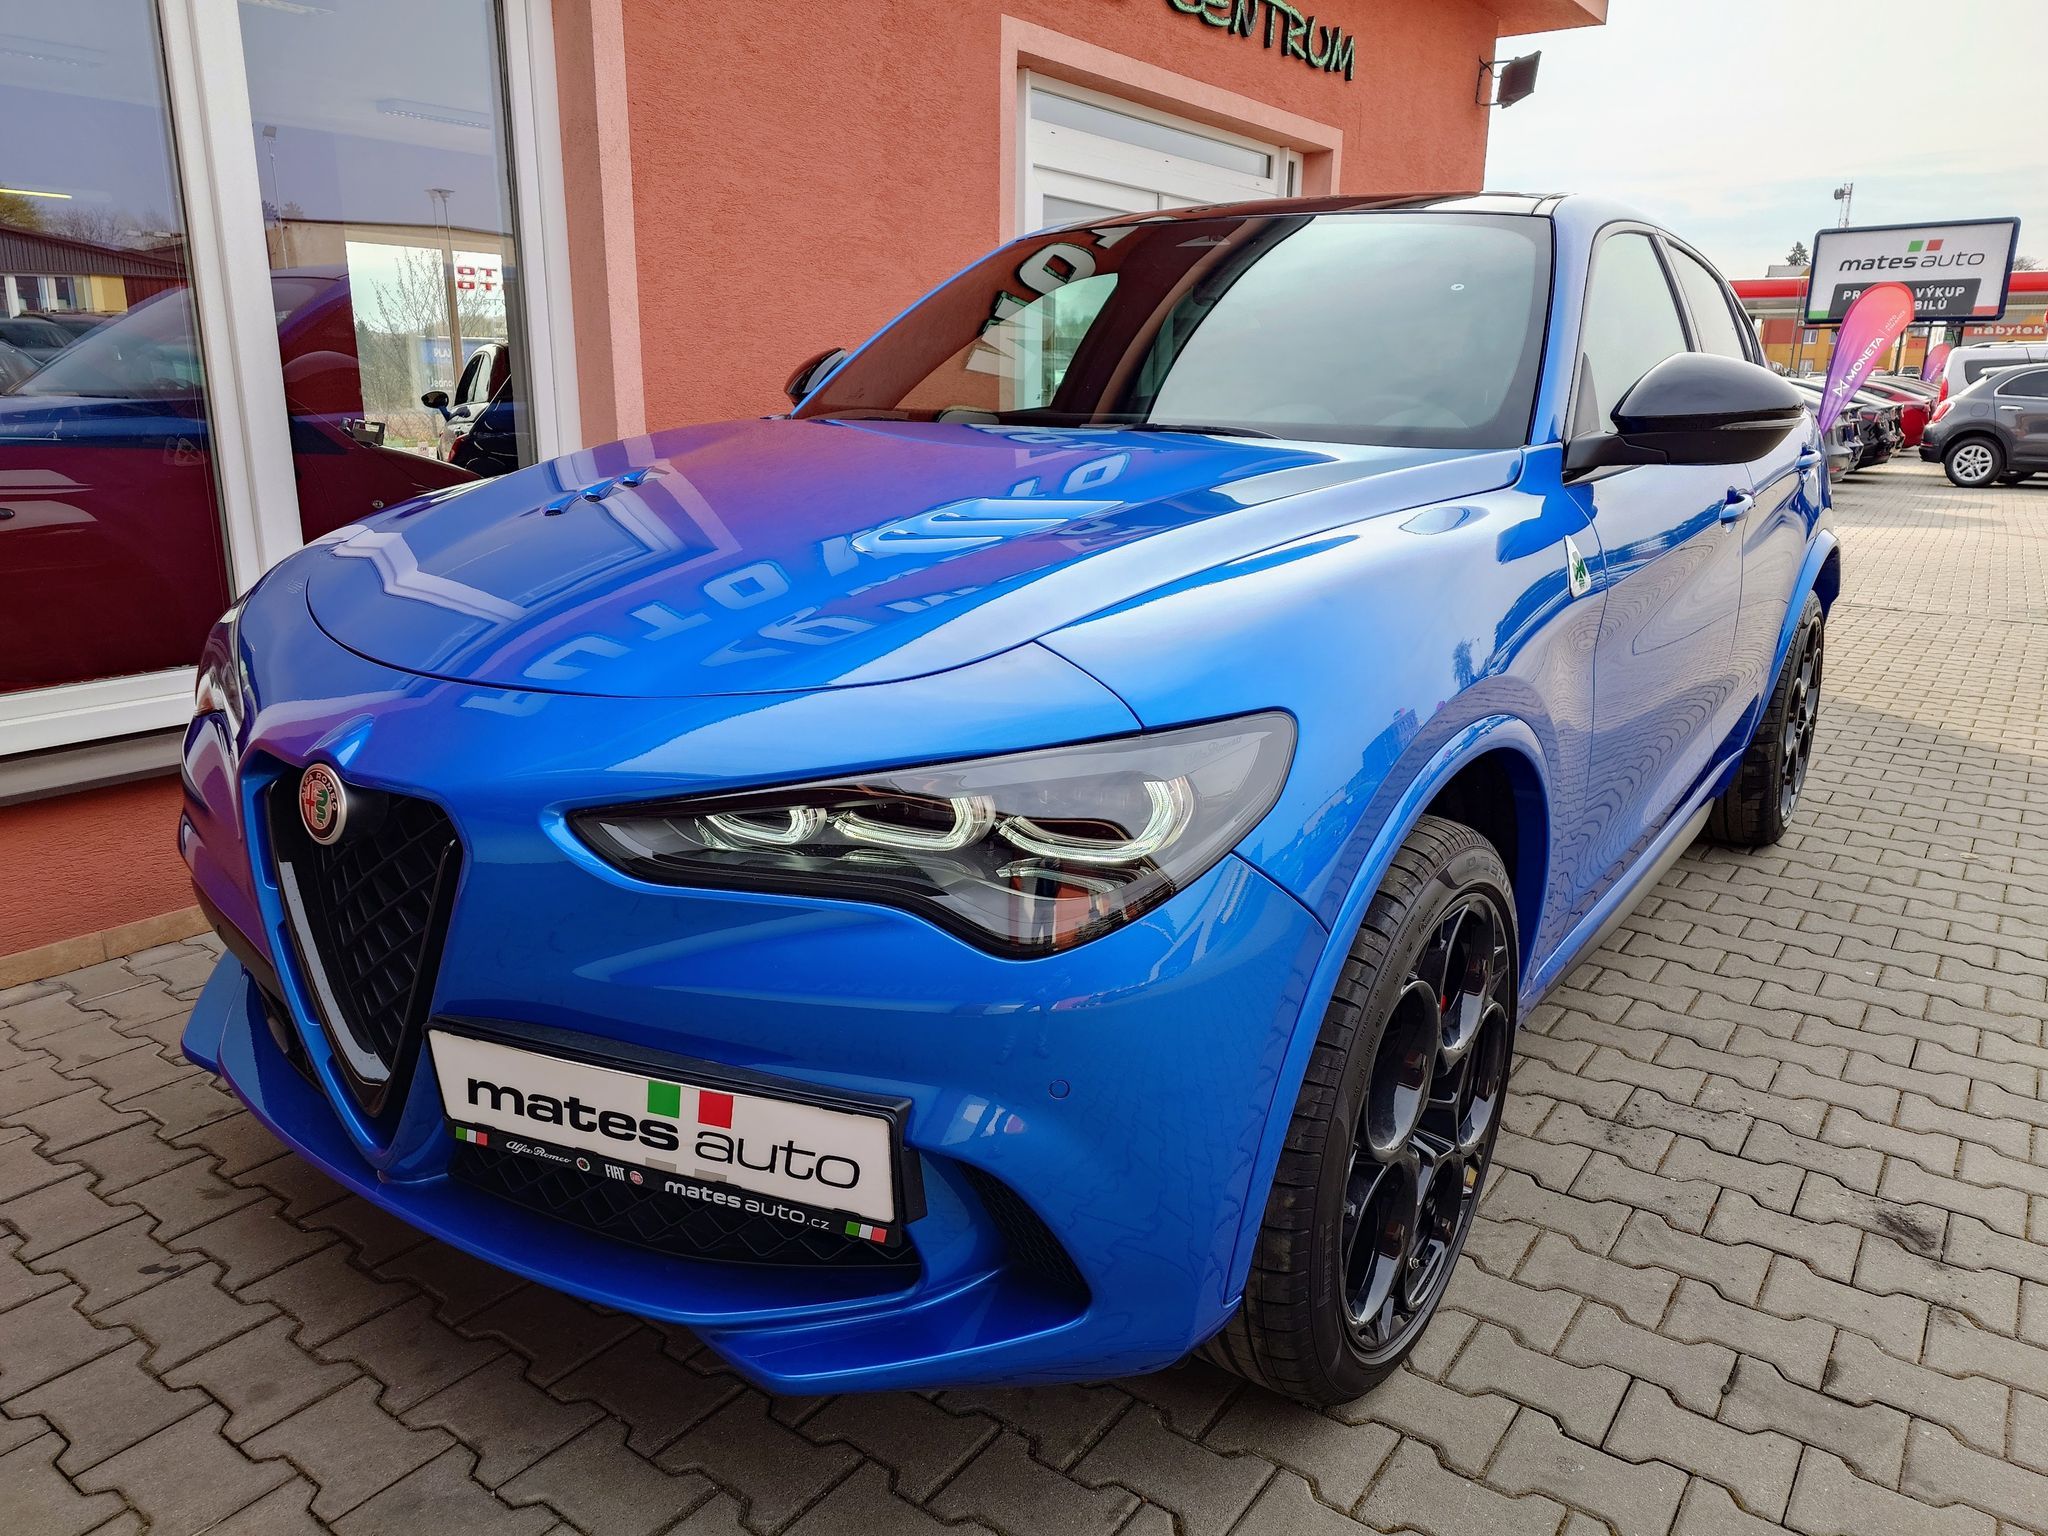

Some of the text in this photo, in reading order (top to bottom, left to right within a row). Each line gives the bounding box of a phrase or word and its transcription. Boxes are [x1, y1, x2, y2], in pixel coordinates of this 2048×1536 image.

[1839, 251, 1986, 272] mates auto
[1916, 285, 1966, 298] VÝKUP
[1846, 336, 1885, 382] MONETA
[315, 772, 338, 812] ROMEO
[466, 1076, 862, 1190] mates auto
[505, 1140, 533, 1154] Alfa
[533, 1146, 572, 1164] Romeo
[604, 1163, 626, 1182] FIAT
